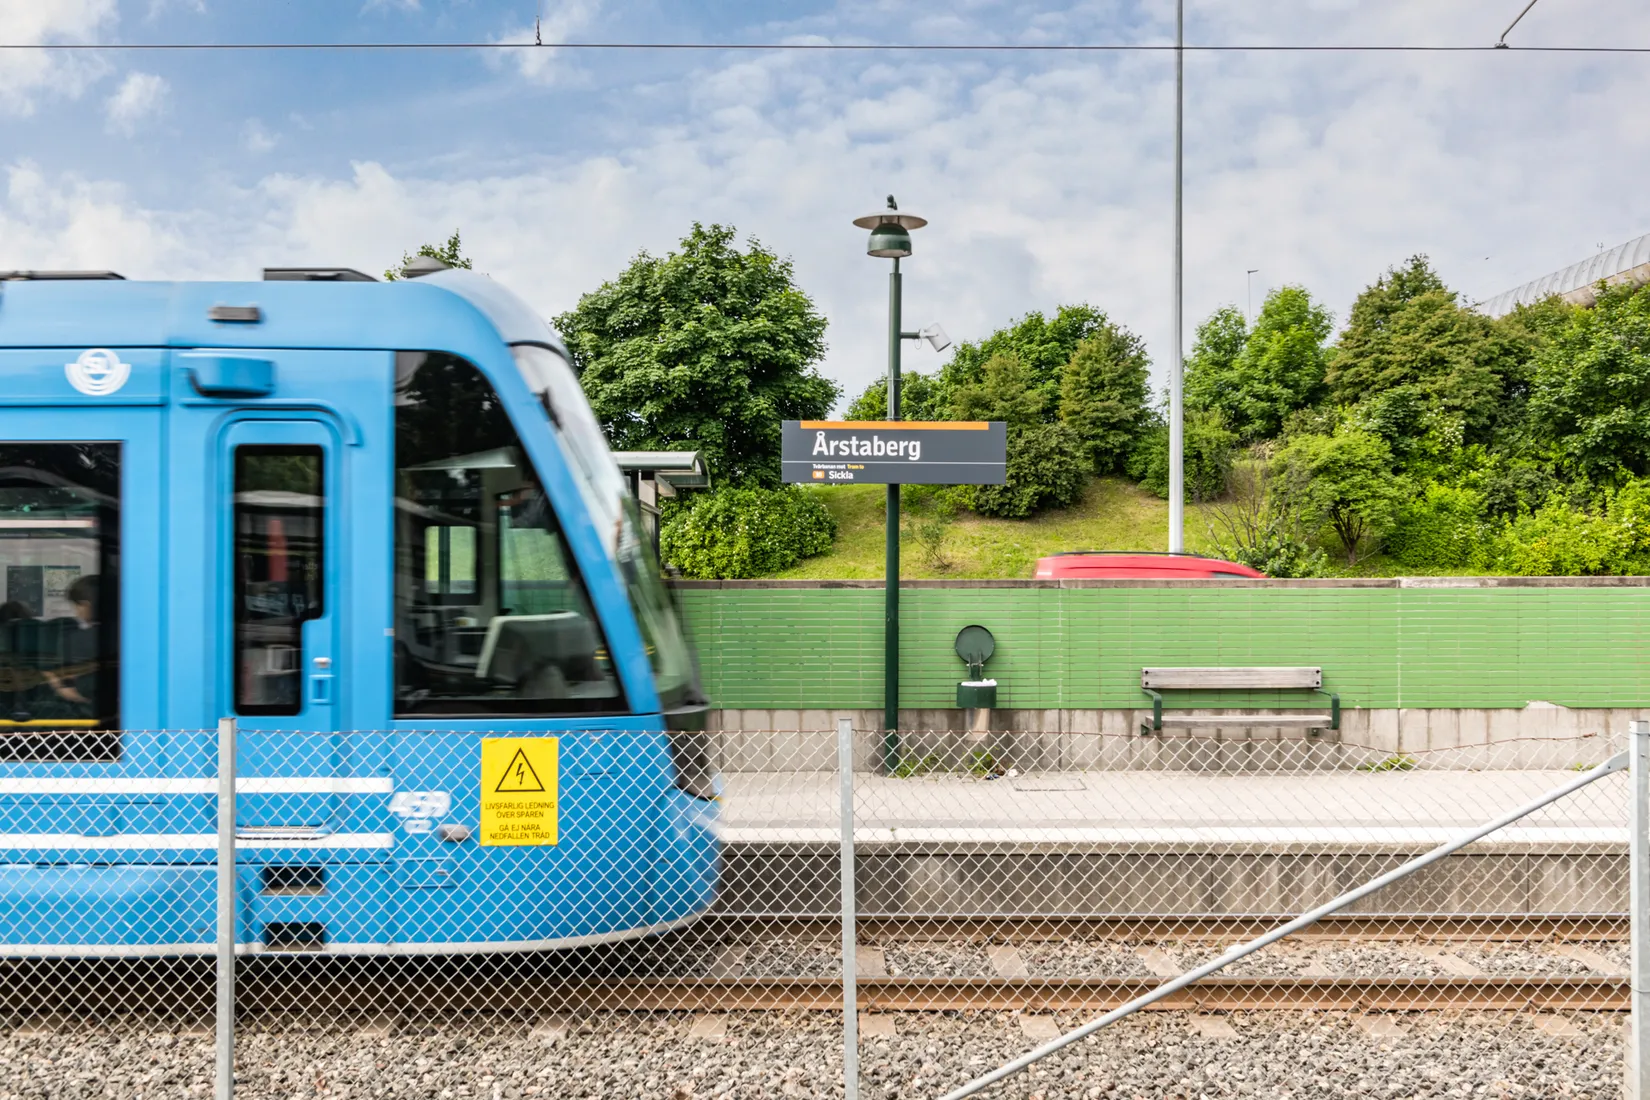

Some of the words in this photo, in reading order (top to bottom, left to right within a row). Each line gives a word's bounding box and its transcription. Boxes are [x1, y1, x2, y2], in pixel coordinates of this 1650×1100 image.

[812, 430, 921, 461] Årstaberg
[828, 470, 854, 480] Sickla
[485, 802, 524, 810] LIVSFARLIG
[490, 832, 530, 840] NEDFALLEN
